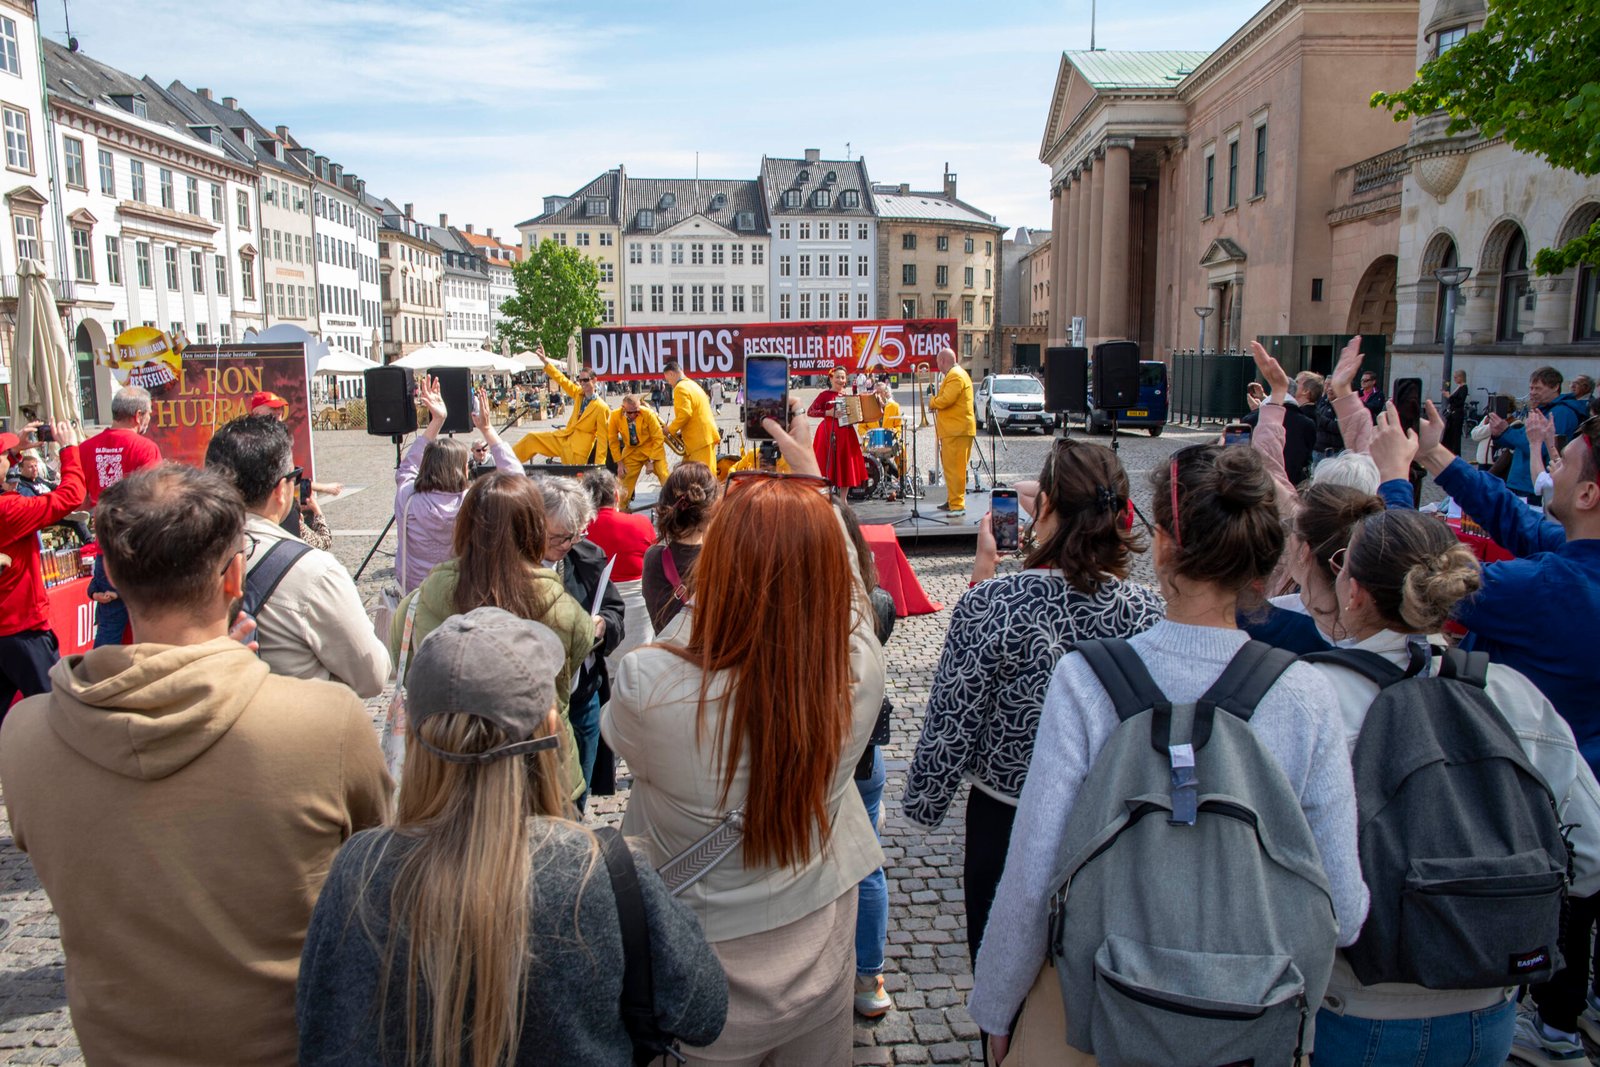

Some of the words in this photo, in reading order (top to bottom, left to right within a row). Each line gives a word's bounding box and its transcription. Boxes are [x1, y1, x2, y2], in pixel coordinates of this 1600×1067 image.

[120, 348, 127, 359] 75
[744, 335, 823, 358] BESTSELLER
[827, 335, 852, 357] FOR
[852, 325, 906, 368] 75
[908, 332, 950, 355] YEARS
[793, 360, 798, 369] 9
[800, 360, 815, 369] MAY
[817, 359, 835, 369] 2025
[130, 367, 175, 388] BESTSELLER
[179, 368, 201, 396] L.
[204, 367, 263, 394] RON
